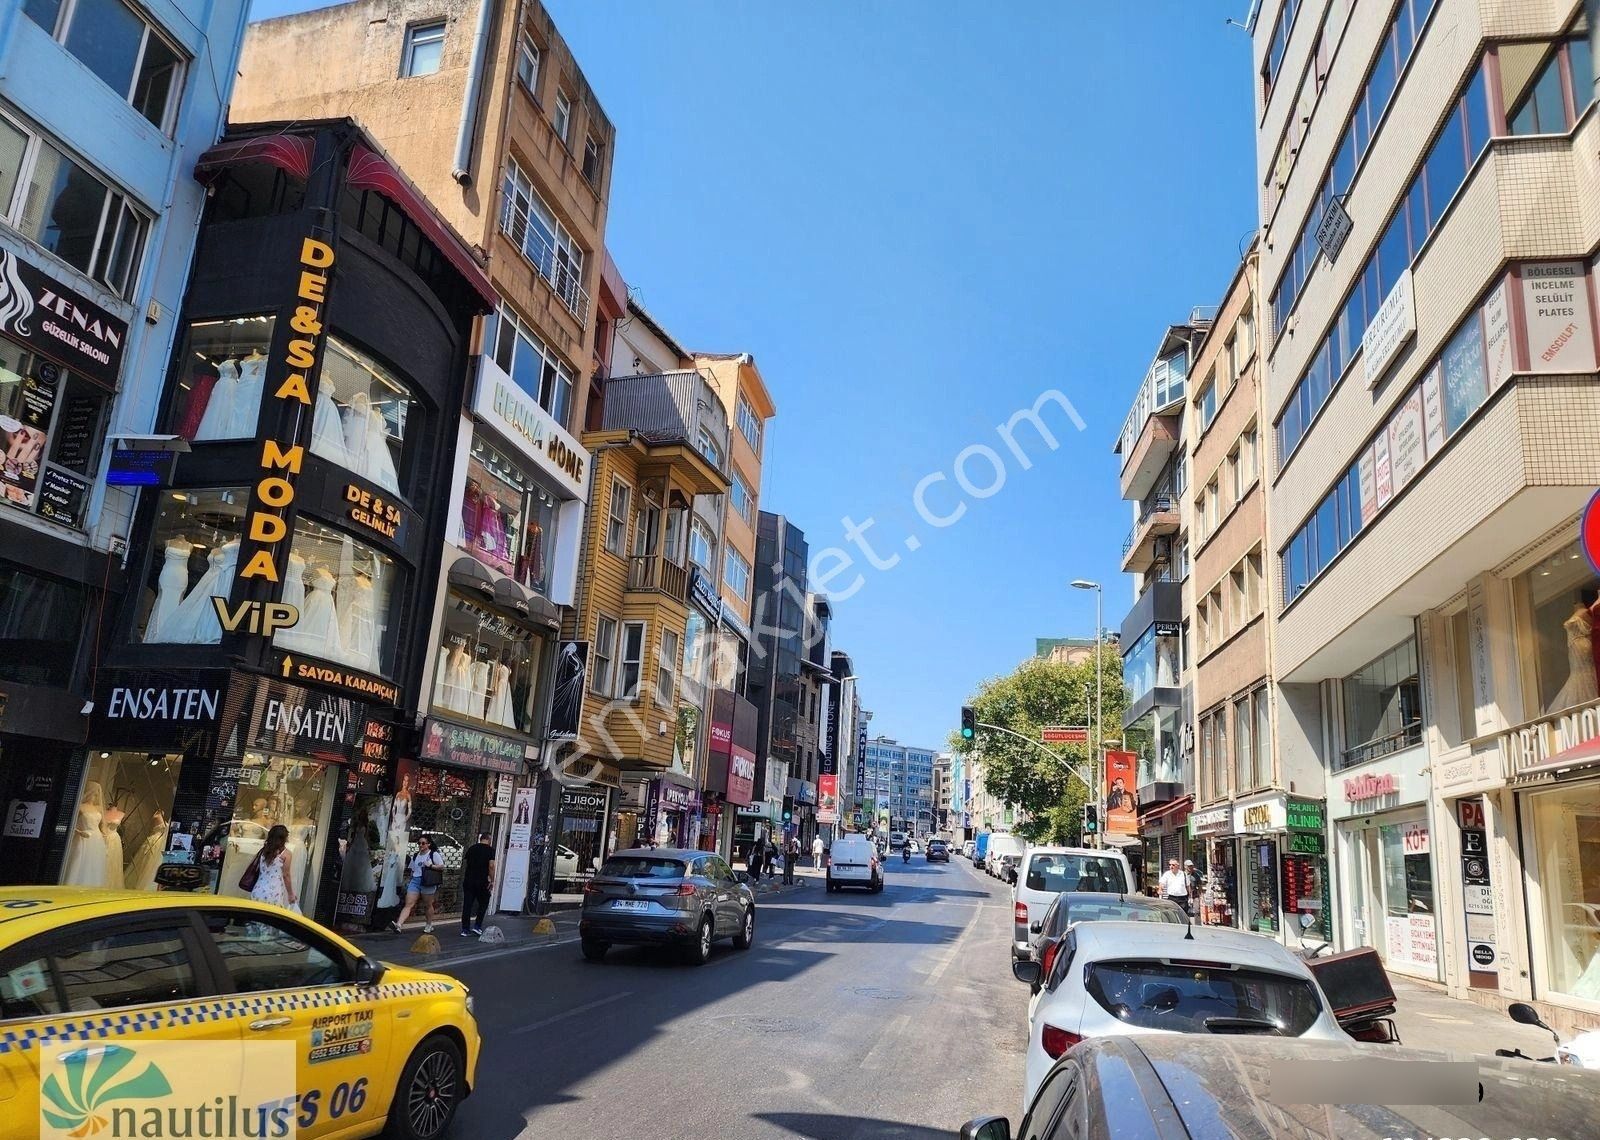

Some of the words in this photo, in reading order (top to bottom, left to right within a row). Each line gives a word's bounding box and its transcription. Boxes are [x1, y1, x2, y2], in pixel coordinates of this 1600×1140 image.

[1528, 266, 1576, 277] BÖLGESEL
[1531, 279, 1575, 291] İNCELME
[1535, 293, 1574, 303] SELÜLİT
[1538, 307, 1574, 317] PLATES
[38, 287, 122, 350] ZENAN
[42, 320, 81, 349] GÜZELLİK
[79, 339, 110, 366] SALONU
[1541, 322, 1579, 362] EMSCULPT
[547, 431, 583, 484] HOME
[240, 440, 304, 582] MODA
[347, 484, 370, 507] DE
[372, 499, 383, 517] &
[386, 504, 401, 527] SA
[351, 508, 396, 540] GELİNLİK
[1156, 623, 1179, 631] PERLA
[298, 664, 343, 685] SAYDA
[107, 687, 220, 721] ENSATEN
[826, 700, 836, 733] STONE
[264, 699, 348, 744] ENSATEN
[1560, 704, 1600, 752] MO
[856, 761, 864, 796] AJANS
[1287, 814, 1321, 829] ALINIR
[1292, 835, 1318, 845] ALTIN
[1405, 825, 1429, 852] KÖF
[1465, 832, 1482, 852] E
[312, 1012, 353, 1030] AIRPORT
[354, 1009, 374, 1022] TAXI
[329, 1077, 369, 1120] 06
